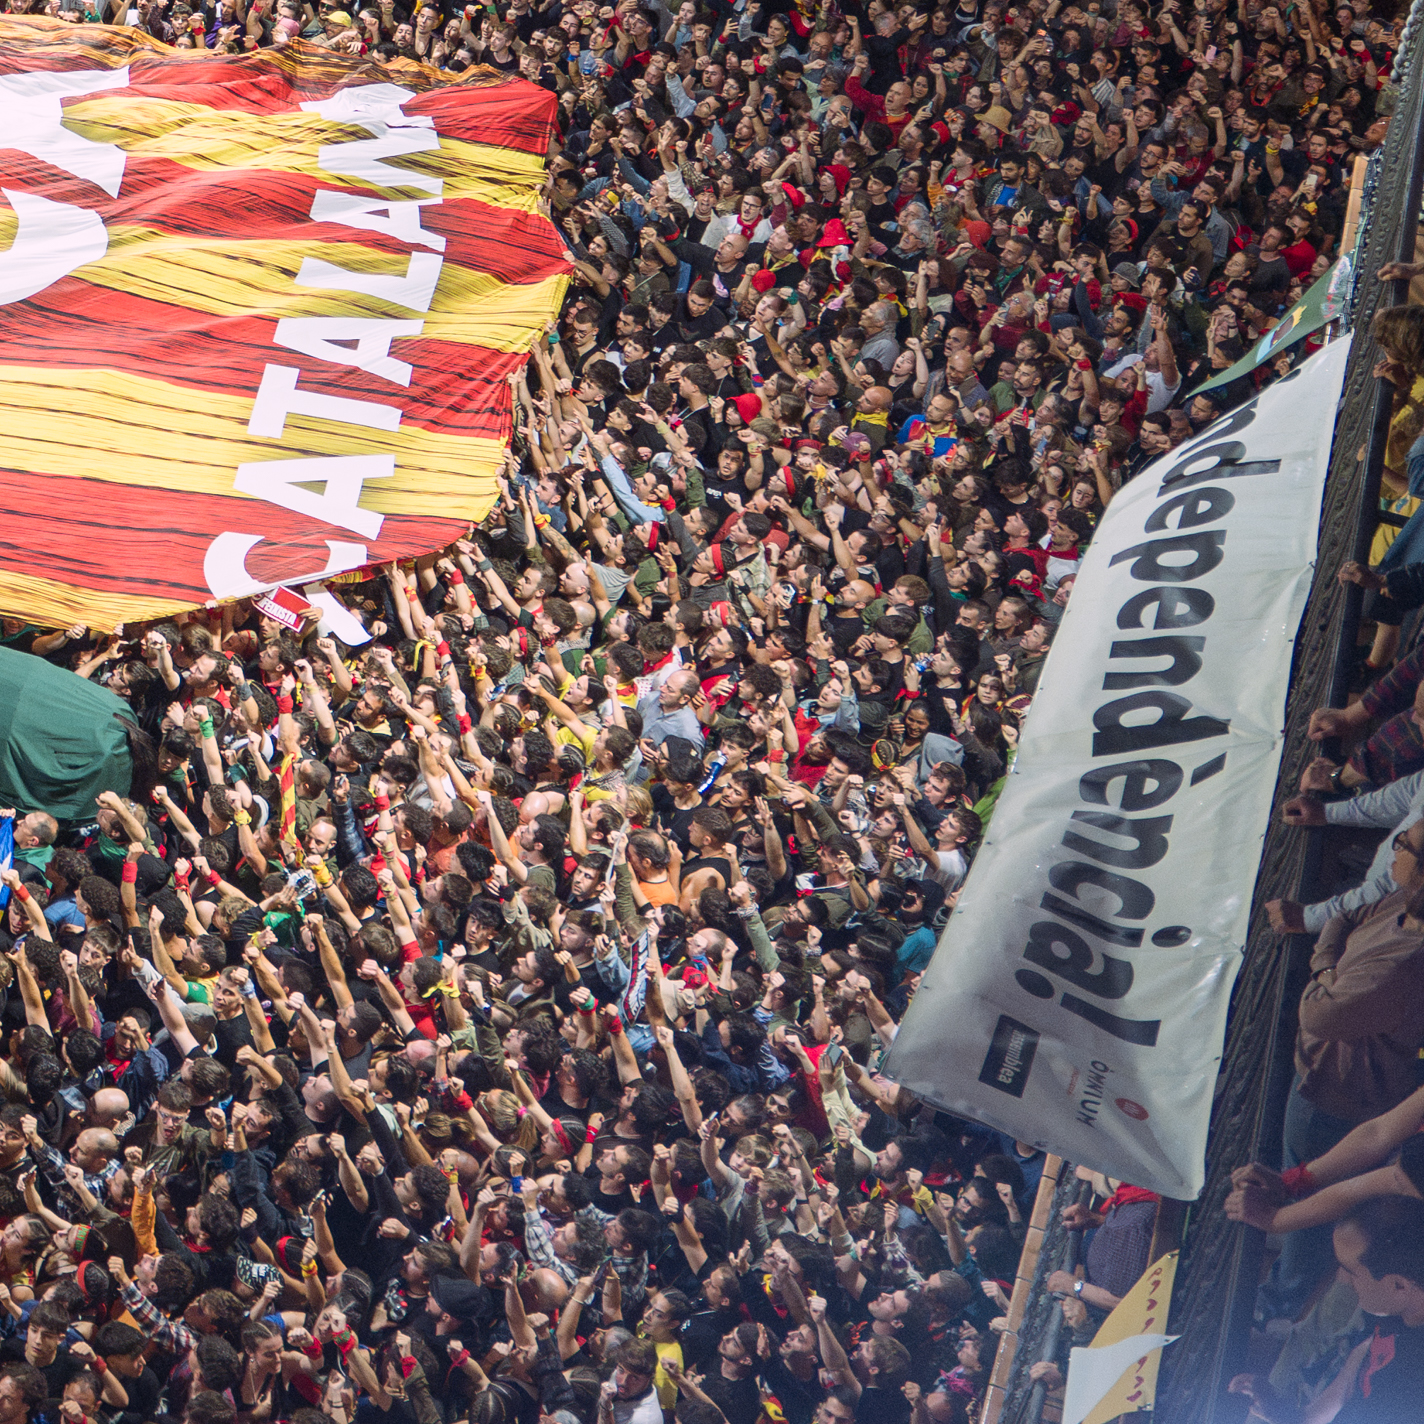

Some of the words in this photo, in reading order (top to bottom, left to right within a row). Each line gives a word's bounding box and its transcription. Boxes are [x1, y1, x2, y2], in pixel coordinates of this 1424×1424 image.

[205, 82, 448, 645] CATALANA
[1014, 376, 1297, 1047] ndependència!
[1076, 1059, 1115, 1127] ÒMNIUM
